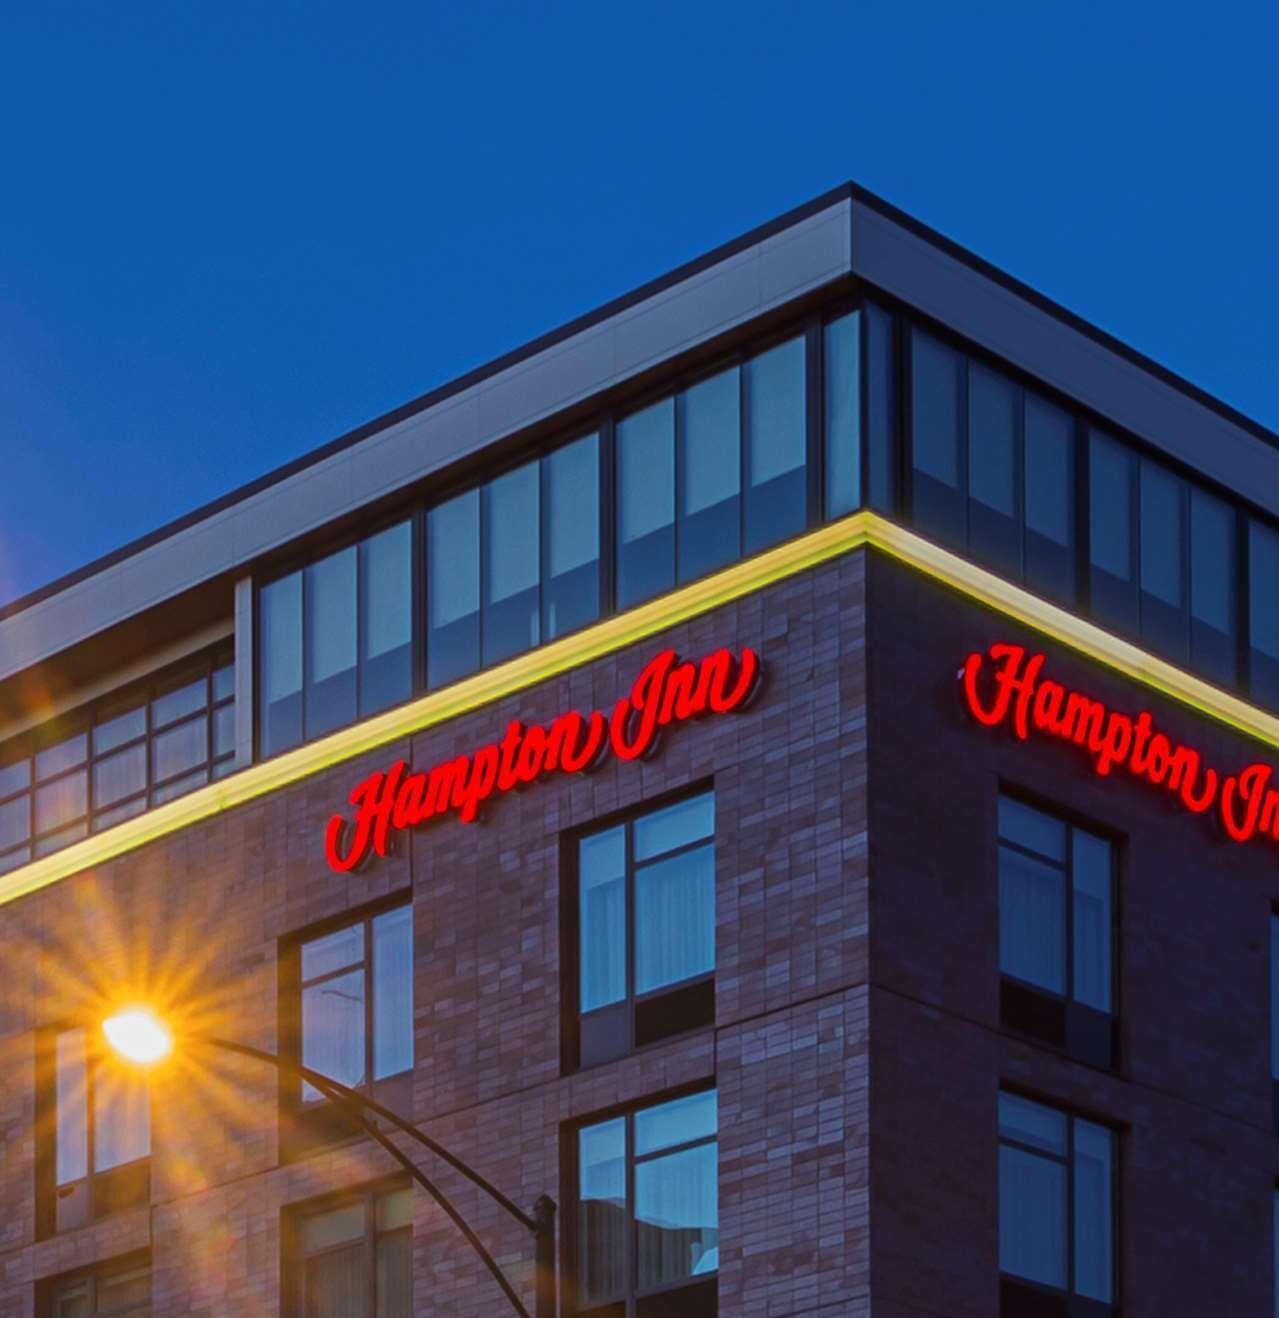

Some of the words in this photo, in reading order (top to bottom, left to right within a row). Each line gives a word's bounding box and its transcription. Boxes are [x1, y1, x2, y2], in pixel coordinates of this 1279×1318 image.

[325, 710, 604, 873] Hampton
[610, 647, 758, 761] Inn
[963, 643, 1218, 813] Hampton
